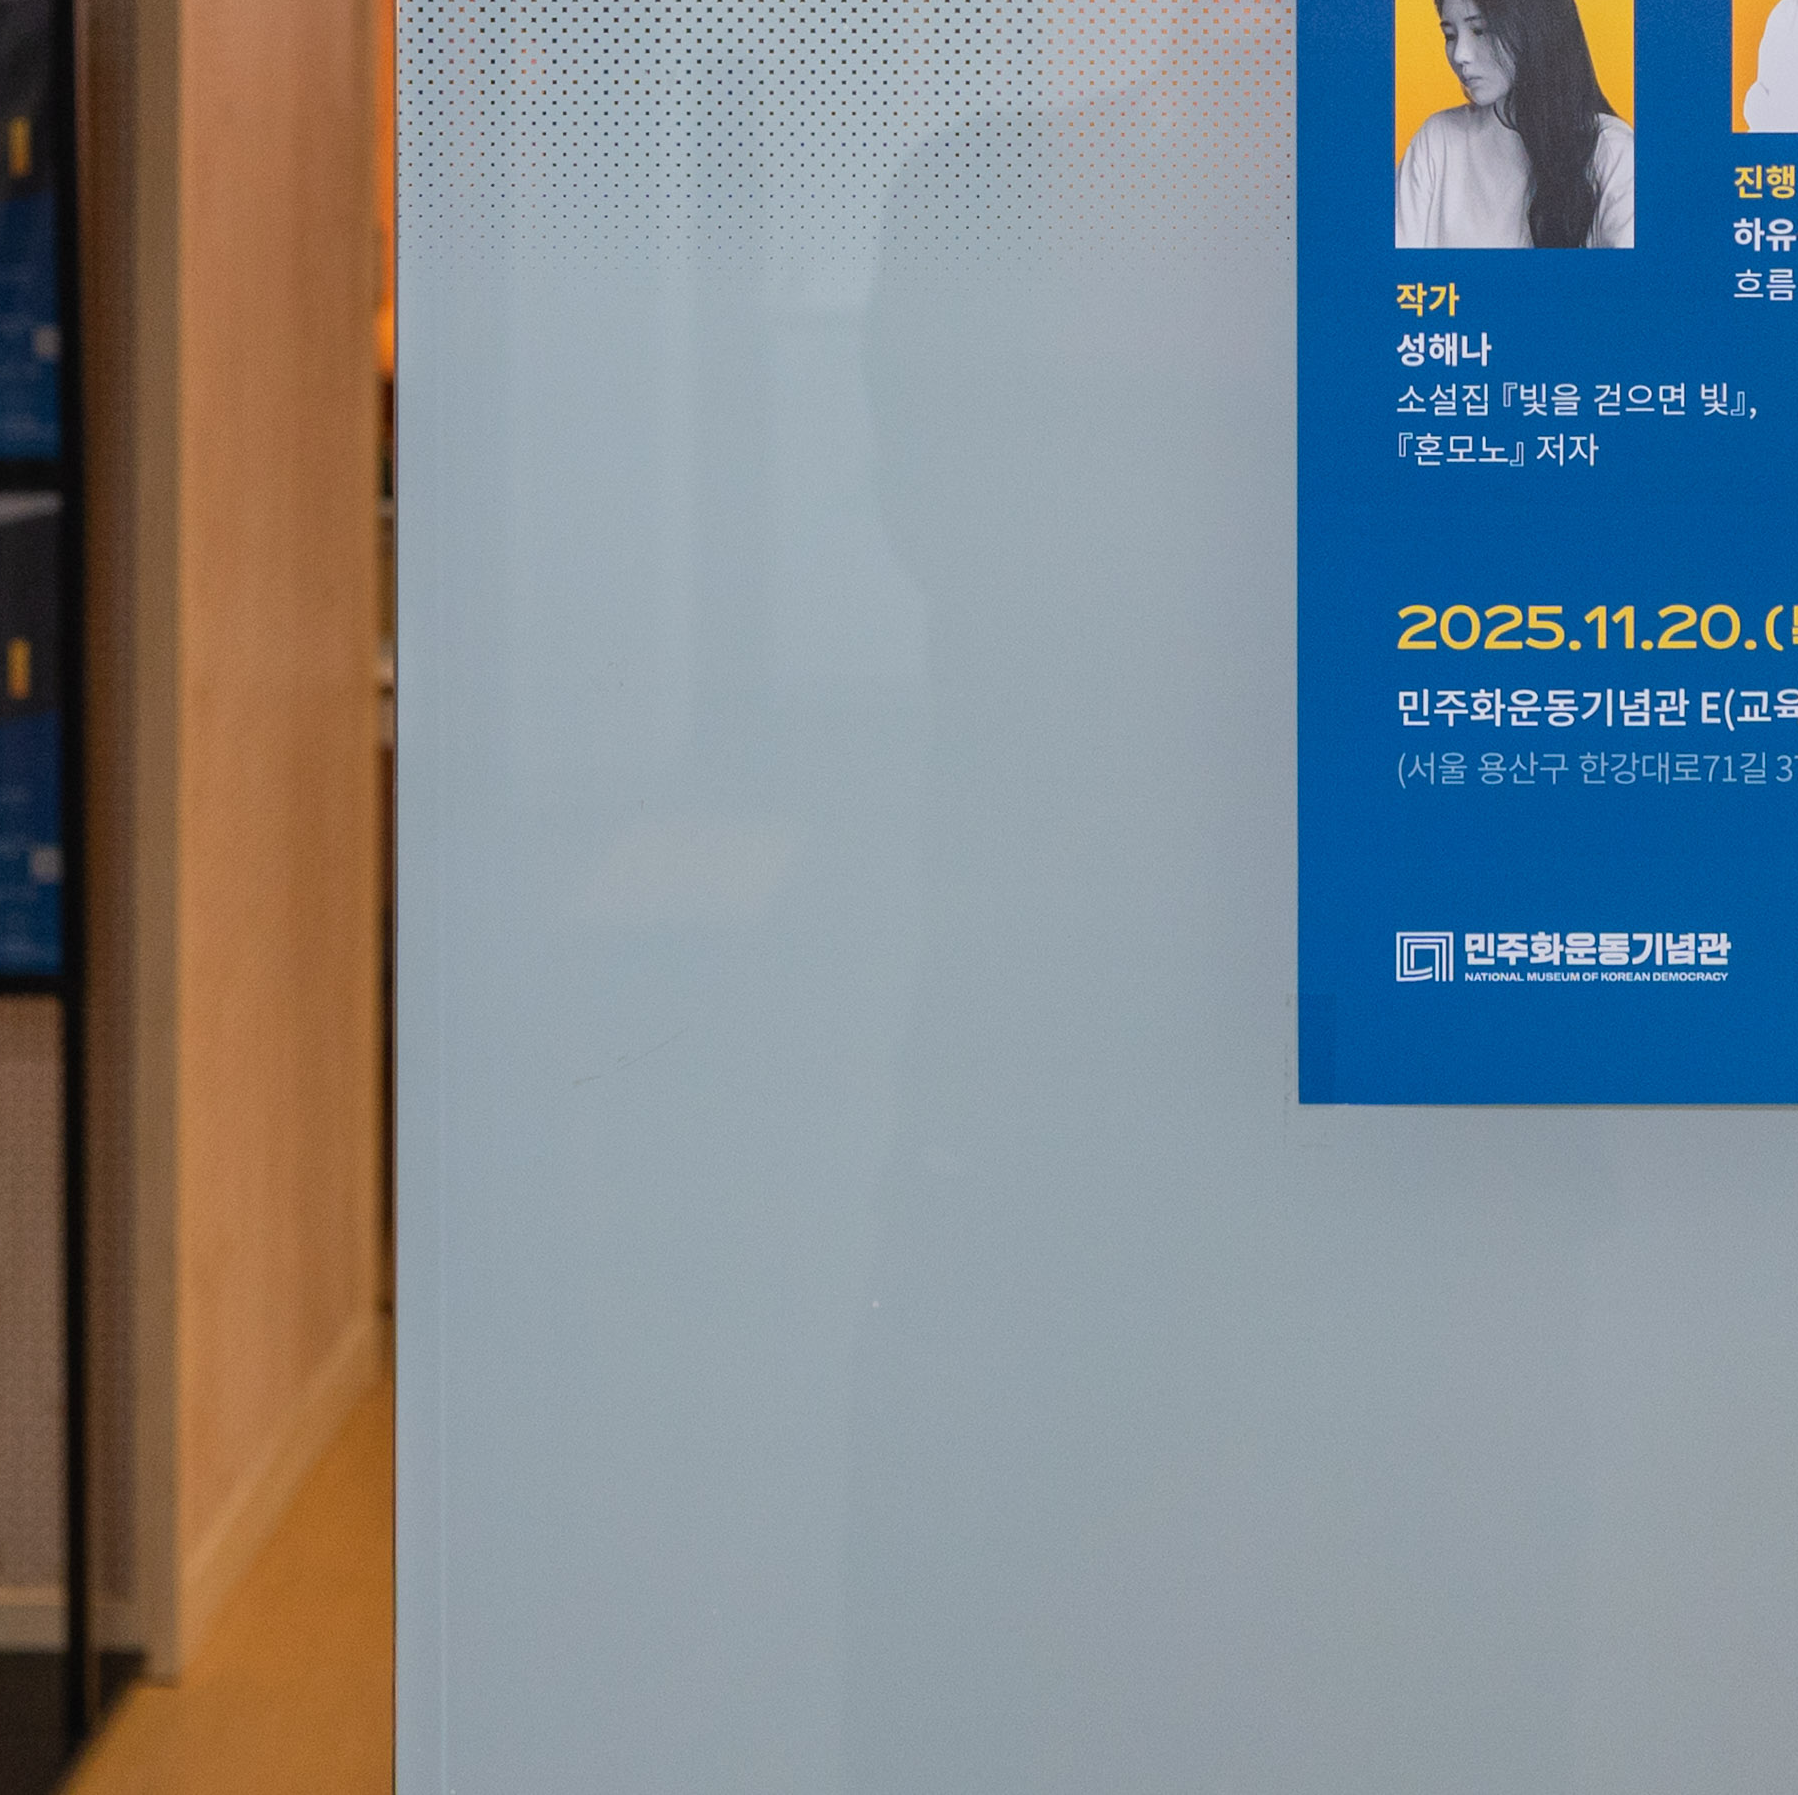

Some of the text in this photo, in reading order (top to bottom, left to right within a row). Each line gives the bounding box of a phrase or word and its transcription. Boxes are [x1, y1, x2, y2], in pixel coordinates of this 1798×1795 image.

[1734, 164, 1796, 200] 진행
[1396, 282, 1461, 317] 작가
[1396, 331, 1493, 367] 성해나
[1396, 383, 1489, 417] 소설집
[1593, 382, 1686, 417] 걷으면
[1536, 432, 1600, 467] 저자
[1398, 687, 1690, 728] 민주화운동기념관
[1397, 751, 1468, 789] (서울
[1477, 751, 1569, 785] 용산구
[1579, 751, 1767, 785] 한강대로71길
[1464, 931, 1732, 966] 민주화운동기념관
[1464, 971, 1730, 982] NATIONAL MUSEUM OF KOREAN DEMOCRACY
